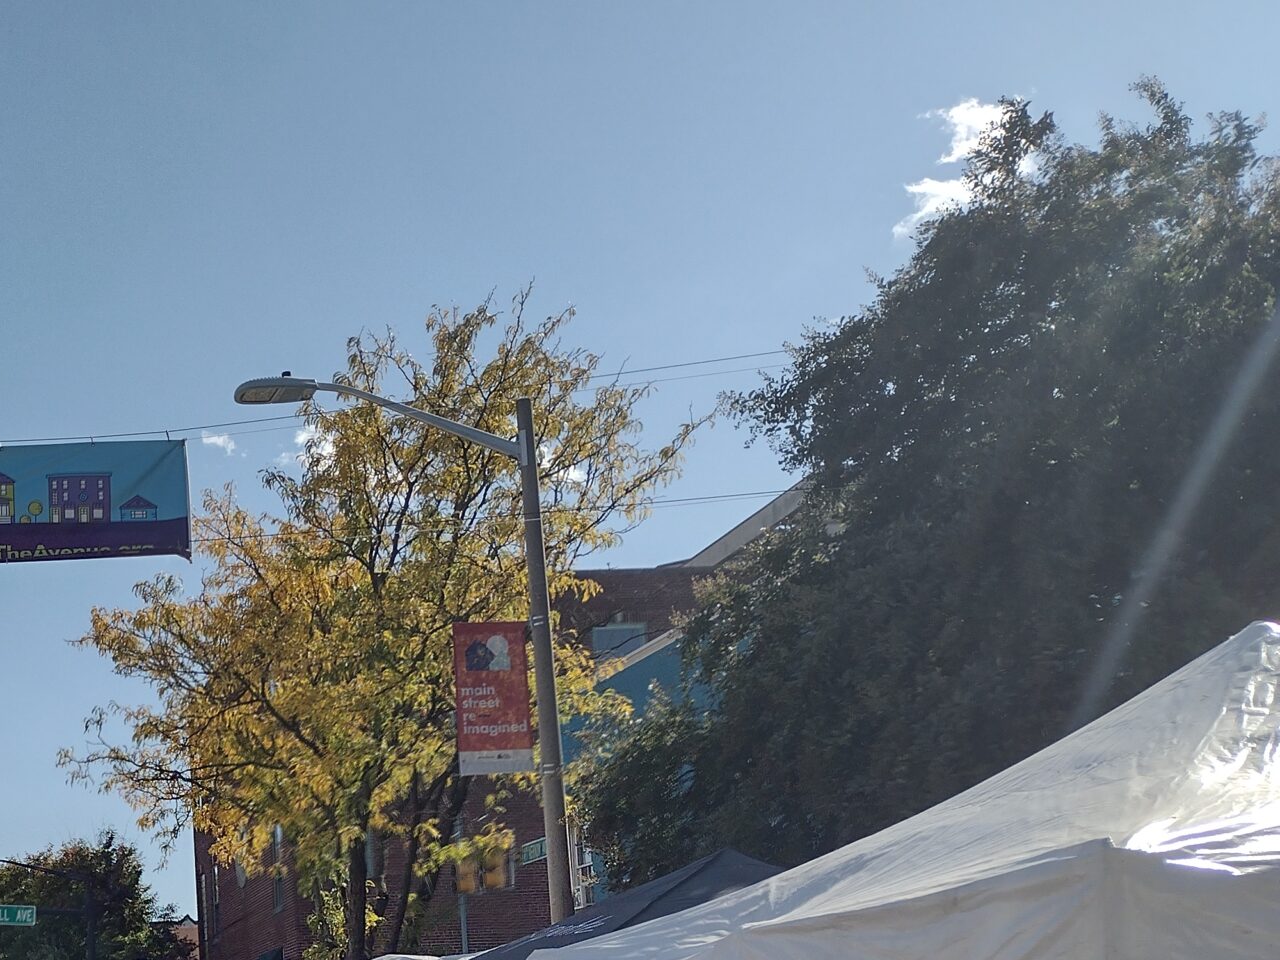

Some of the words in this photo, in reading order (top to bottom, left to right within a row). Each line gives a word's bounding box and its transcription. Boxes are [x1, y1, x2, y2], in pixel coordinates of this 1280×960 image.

[461, 683, 495, 696] main
[462, 697, 500, 708] street
[463, 720, 528, 736] imagined
[15, 909, 33, 922] AVE
